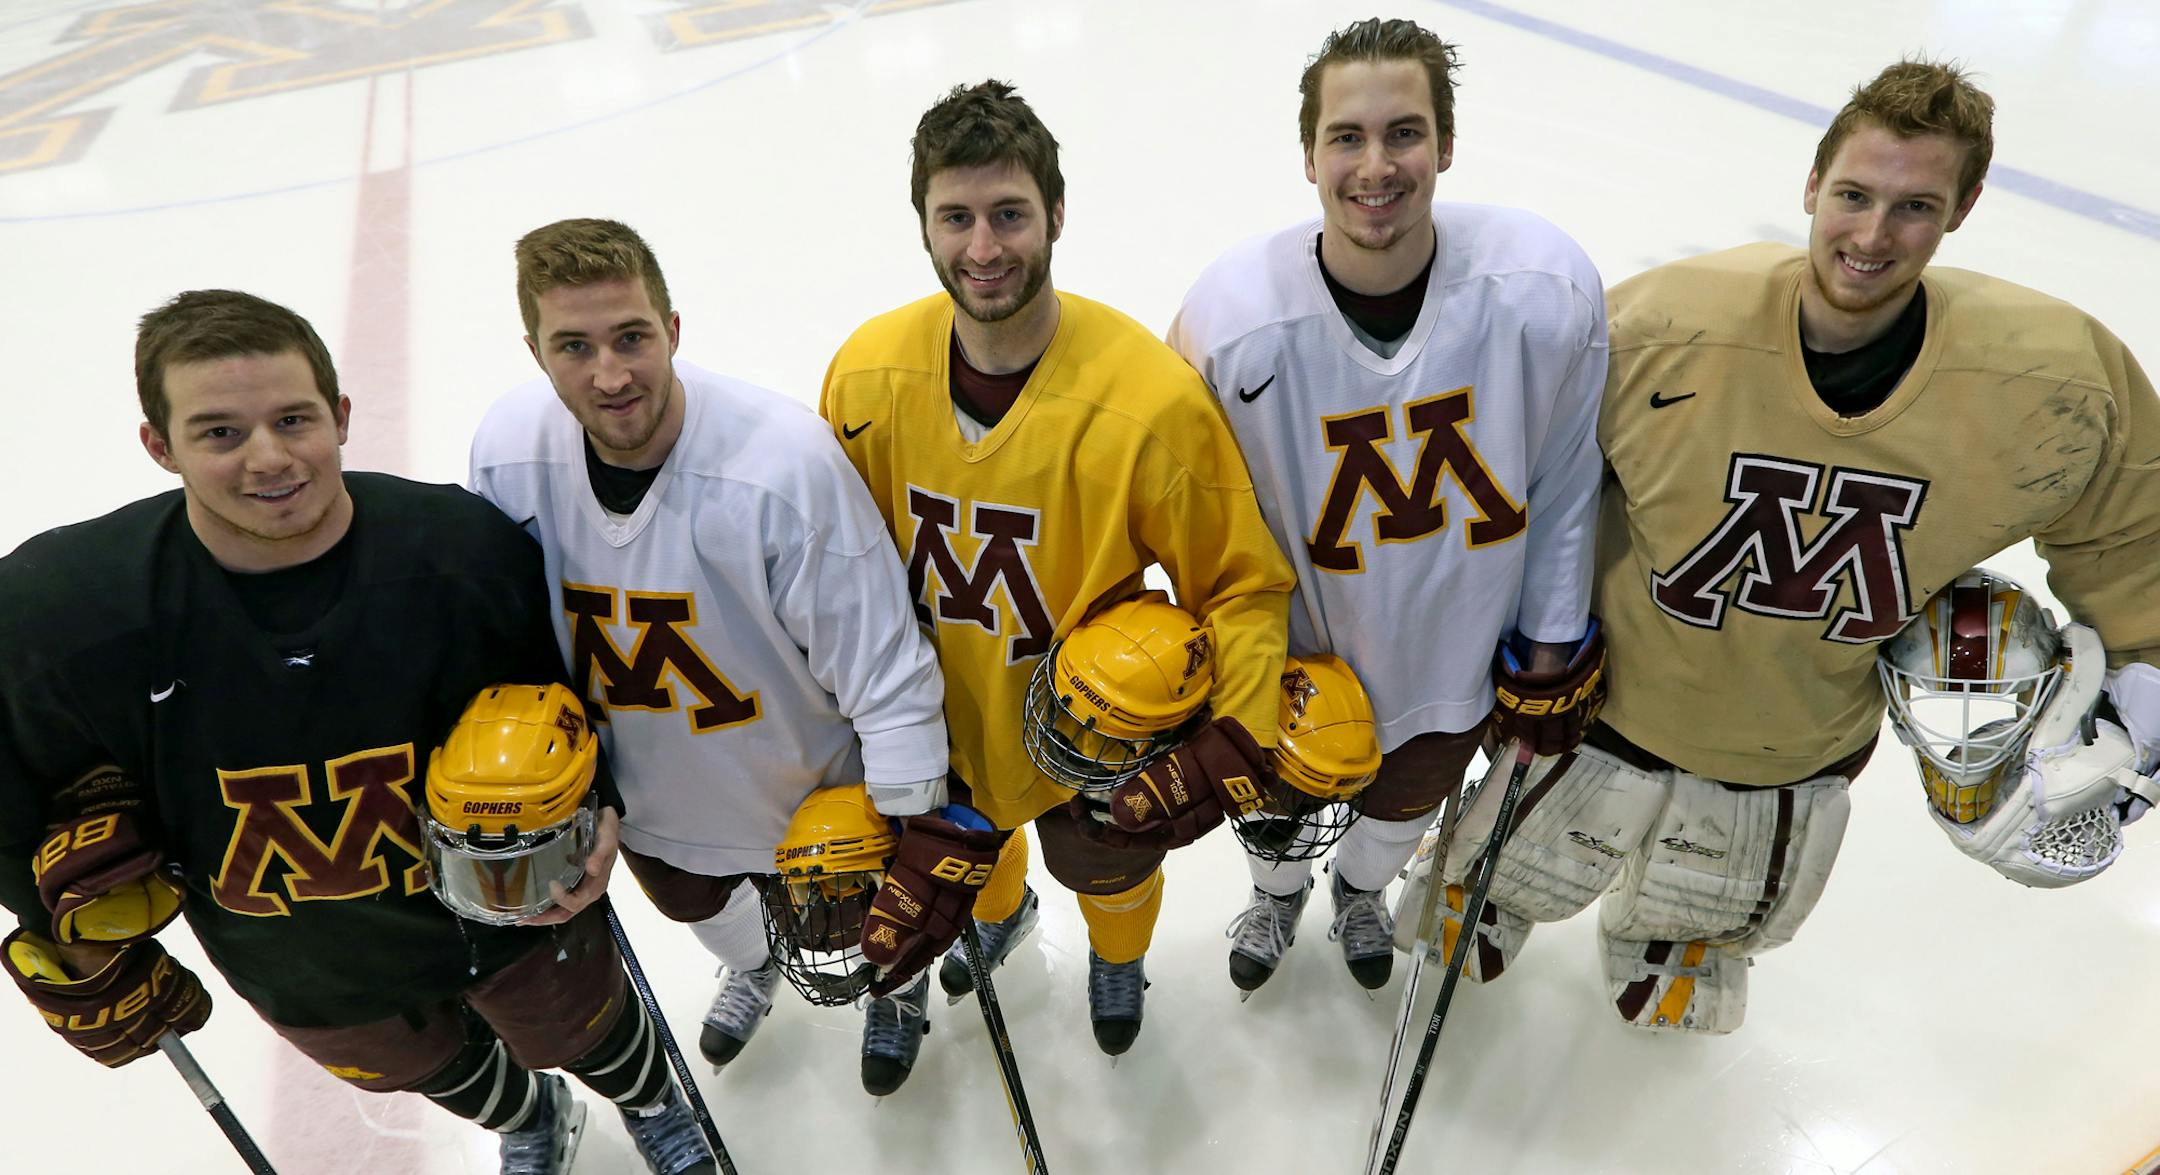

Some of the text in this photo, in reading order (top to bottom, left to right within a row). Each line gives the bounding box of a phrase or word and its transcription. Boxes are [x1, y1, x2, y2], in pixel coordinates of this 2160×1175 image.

[1304, 385, 1529, 575] M
[1651, 452, 1931, 644] M
[904, 482, 1057, 667] M
[561, 579, 763, 735] M
[1069, 675, 1111, 712] GOPHERS
[1166, 763, 1190, 803] NEXUS
[1169, 782, 1184, 806] 1000
[463, 801, 523, 815] GOPHERS
[208, 742, 431, 917] M
[888, 885, 923, 913] NEXUS
[897, 900, 919, 918] 1000
[1428, 1013, 1442, 1035] HOLL
[672, 1051, 697, 1095] PARENTEAU
